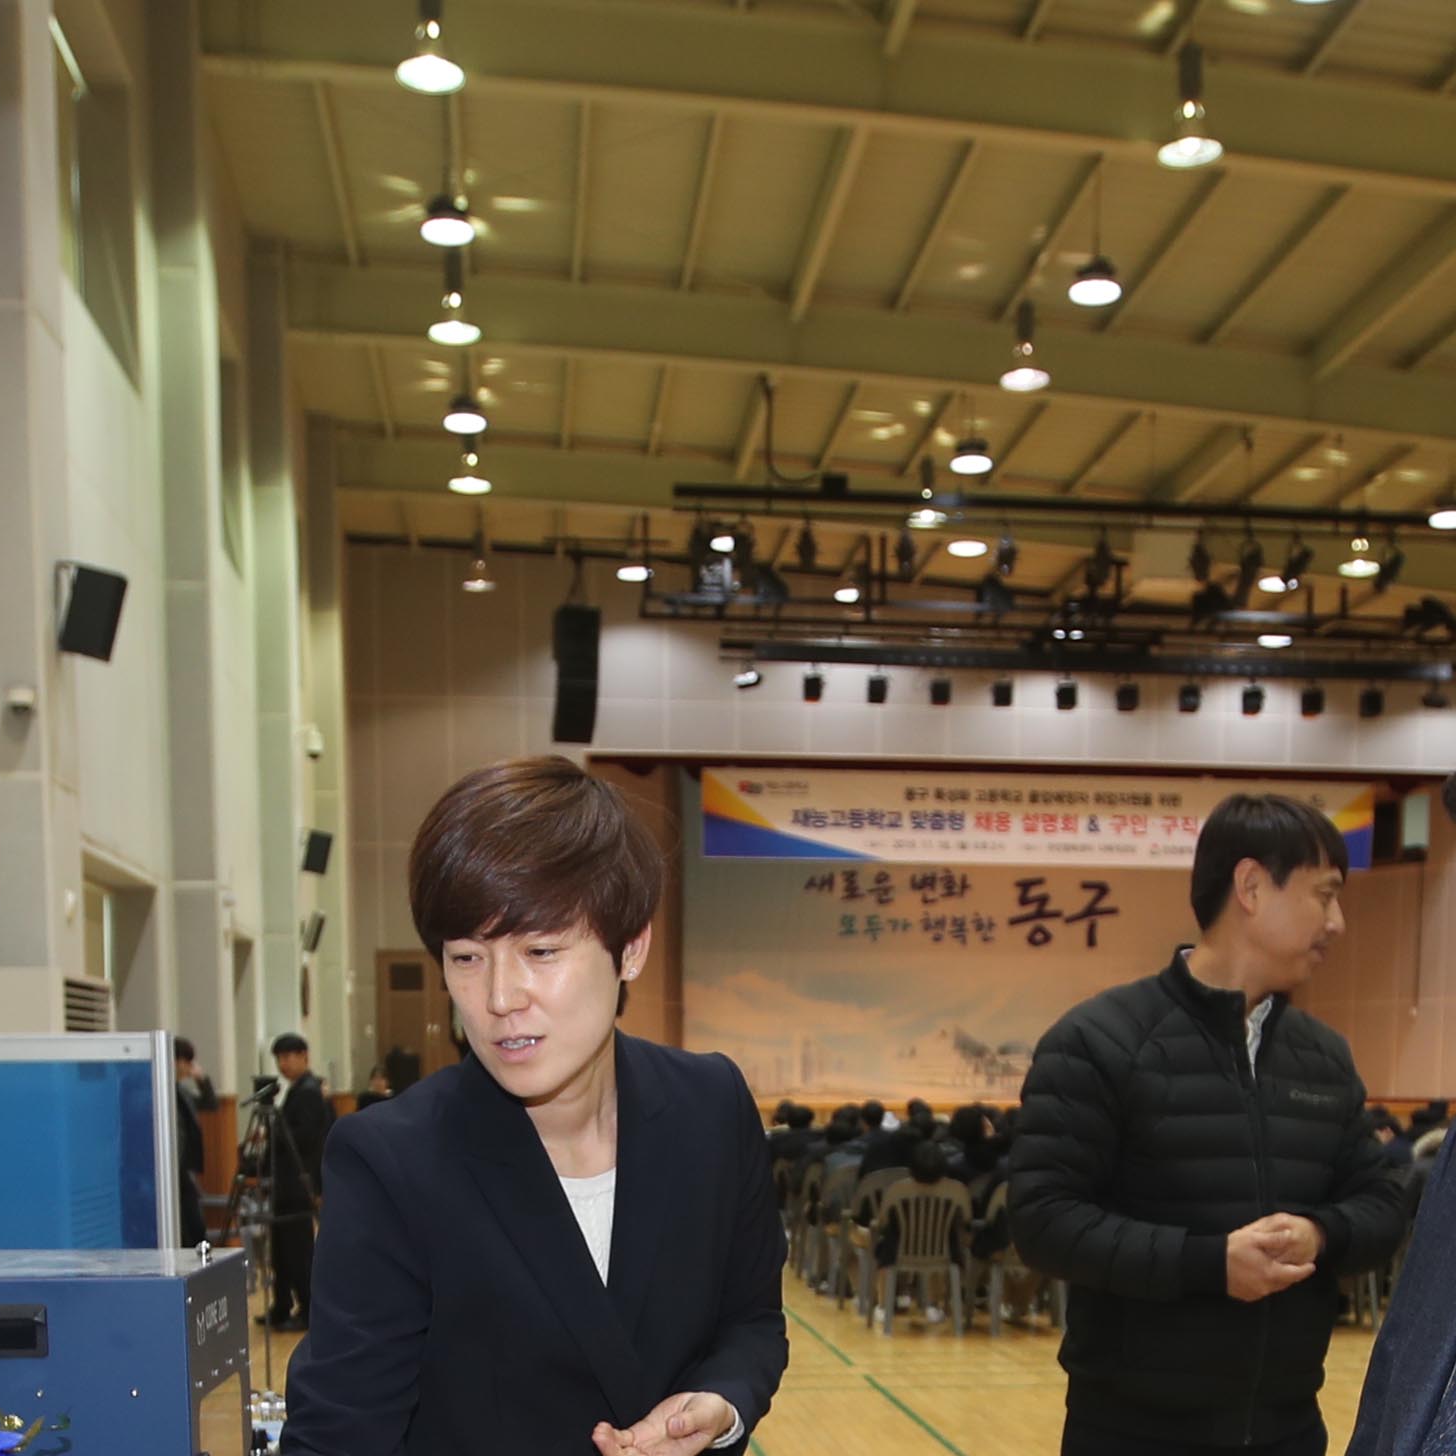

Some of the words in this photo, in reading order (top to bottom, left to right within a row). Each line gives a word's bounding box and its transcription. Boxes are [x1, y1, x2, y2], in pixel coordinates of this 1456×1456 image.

[791, 808, 902, 830] 재능고등학교
[909, 810, 966, 832] 맞춤형
[973, 811, 1012, 834] 채용
[1021, 813, 1079, 835] 설명회
[1087, 814, 1100, 834] &
[1109, 813, 1148, 836] 구인
[1159, 815, 1199, 838] 구직
[804, 869, 895, 905] 새로운
[910, 868, 972, 905] 변화
[838, 913, 912, 944] 모두가
[919, 911, 997, 945] 행복한
[1008, 876, 1120, 948] 동구
